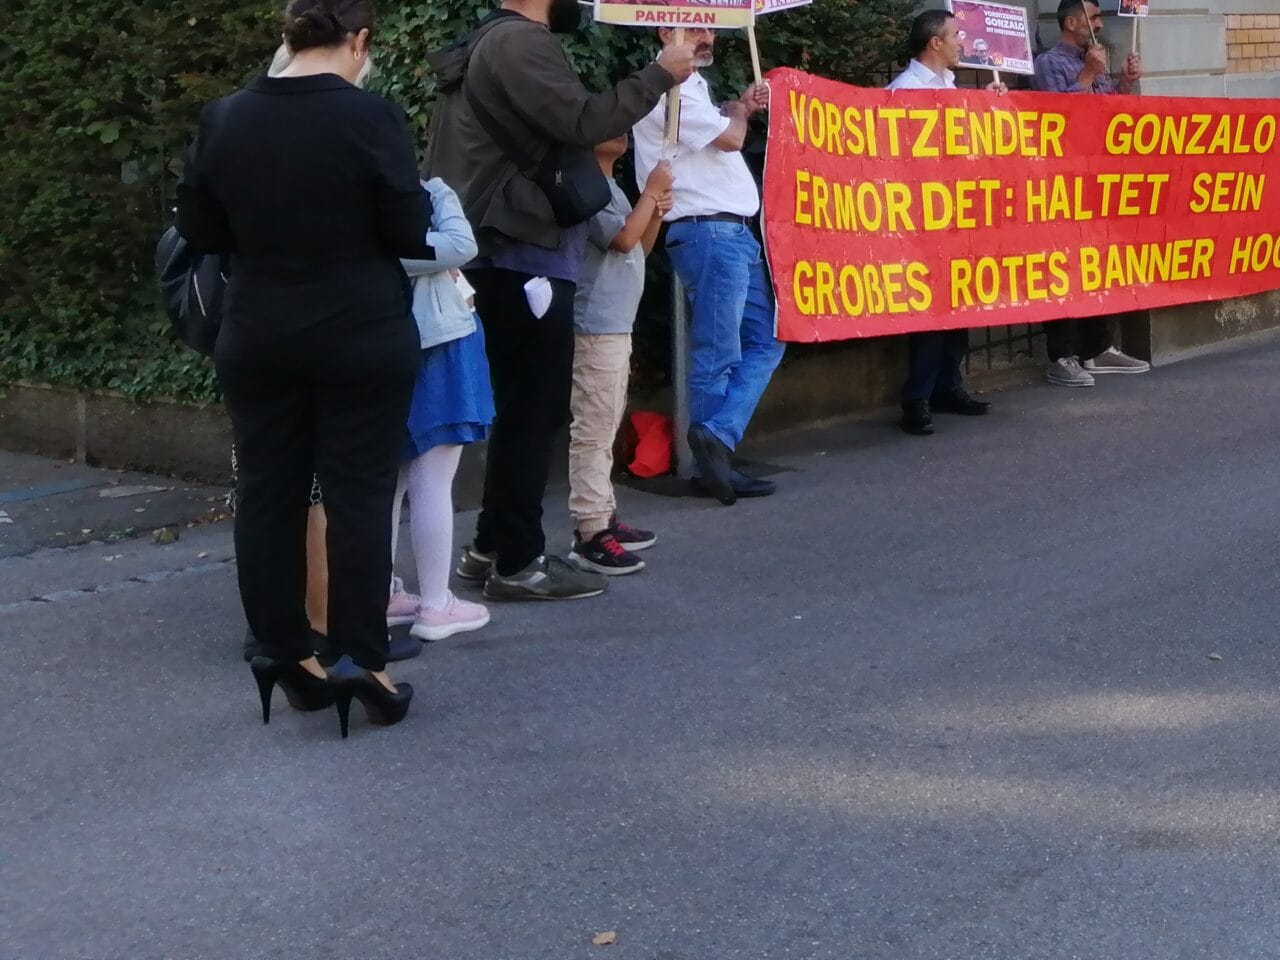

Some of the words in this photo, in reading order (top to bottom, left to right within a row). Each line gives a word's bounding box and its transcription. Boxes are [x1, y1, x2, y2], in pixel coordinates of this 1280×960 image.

[985, 17, 1025, 31] GONZALO
[790, 90, 1066, 157] VORSITZENDER
[1105, 113, 1276, 155] GONZALO
[1026, 173, 1169, 222] HALTET
[1189, 172, 1266, 213] SEIN
[951, 251, 1070, 308] ROTES
[1080, 238, 1215, 292] BANNER
